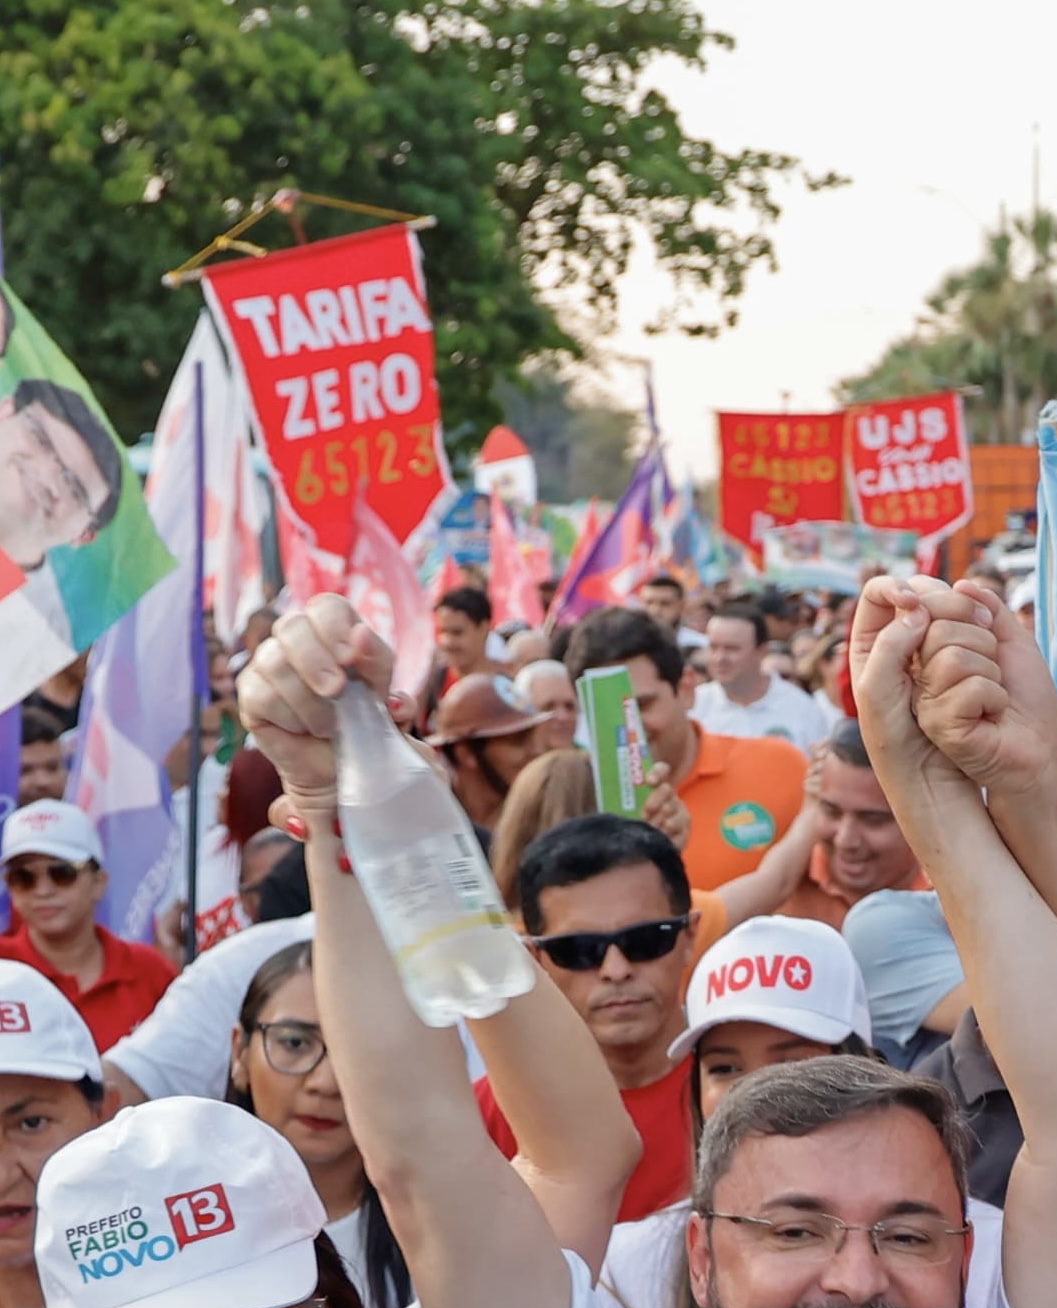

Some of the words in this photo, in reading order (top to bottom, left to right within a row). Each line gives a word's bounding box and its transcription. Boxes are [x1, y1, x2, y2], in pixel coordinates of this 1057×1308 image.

[233, 276, 434, 358] TARIFA
[275, 353, 422, 440] ZERO
[857, 408, 948, 450] UJS
[296, 424, 436, 505] 65123
[706, 955, 812, 1005] NOVO
[65, 1206, 143, 1241] PREFEITO
[170, 1190, 227, 1237] 13
[68, 1220, 149, 1260] FABIO
[78, 1235, 176, 1284] NOVO
